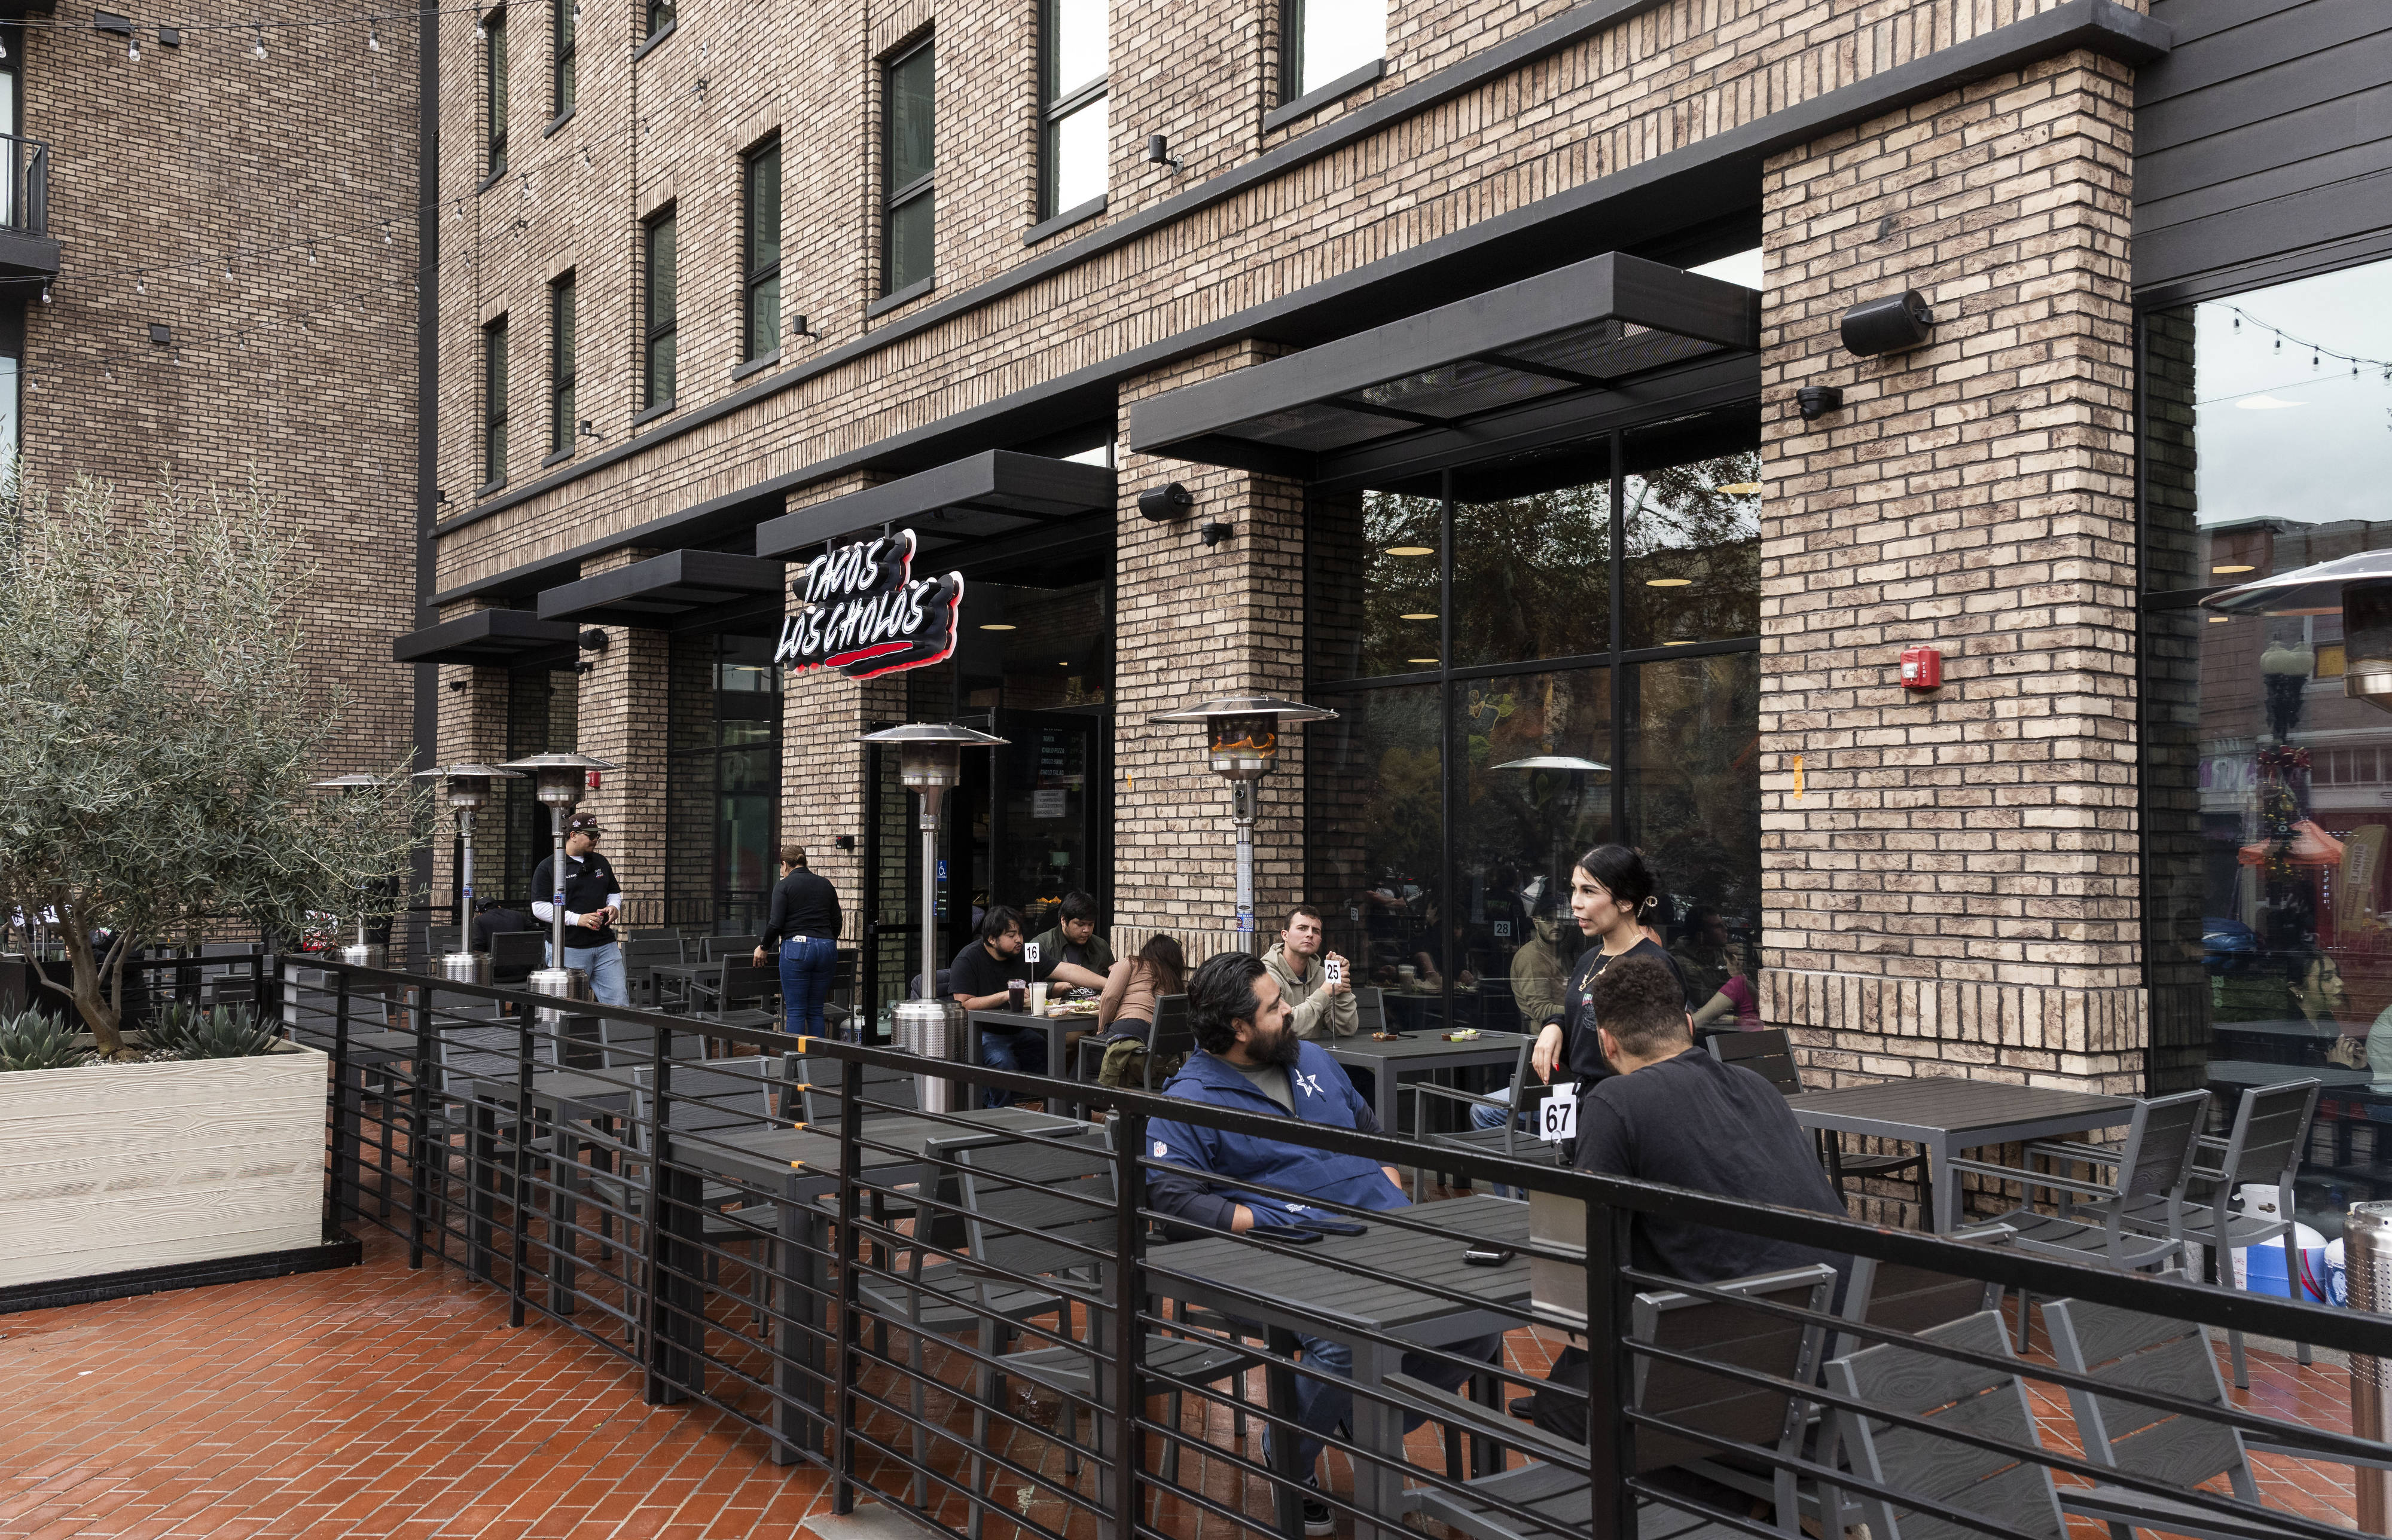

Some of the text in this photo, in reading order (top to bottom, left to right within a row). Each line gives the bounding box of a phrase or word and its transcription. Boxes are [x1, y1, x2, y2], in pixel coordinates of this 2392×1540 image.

[805, 537, 884, 603] TACOS
[774, 582, 930, 662] LOS CHOLOS
[1497, 924, 1508, 934] 28
[1027, 946, 1037, 959] 16
[1327, 964, 1339, 980] 25
[1546, 1104, 1572, 1133] 67
[1156, 1146, 1166, 1154] NFL
